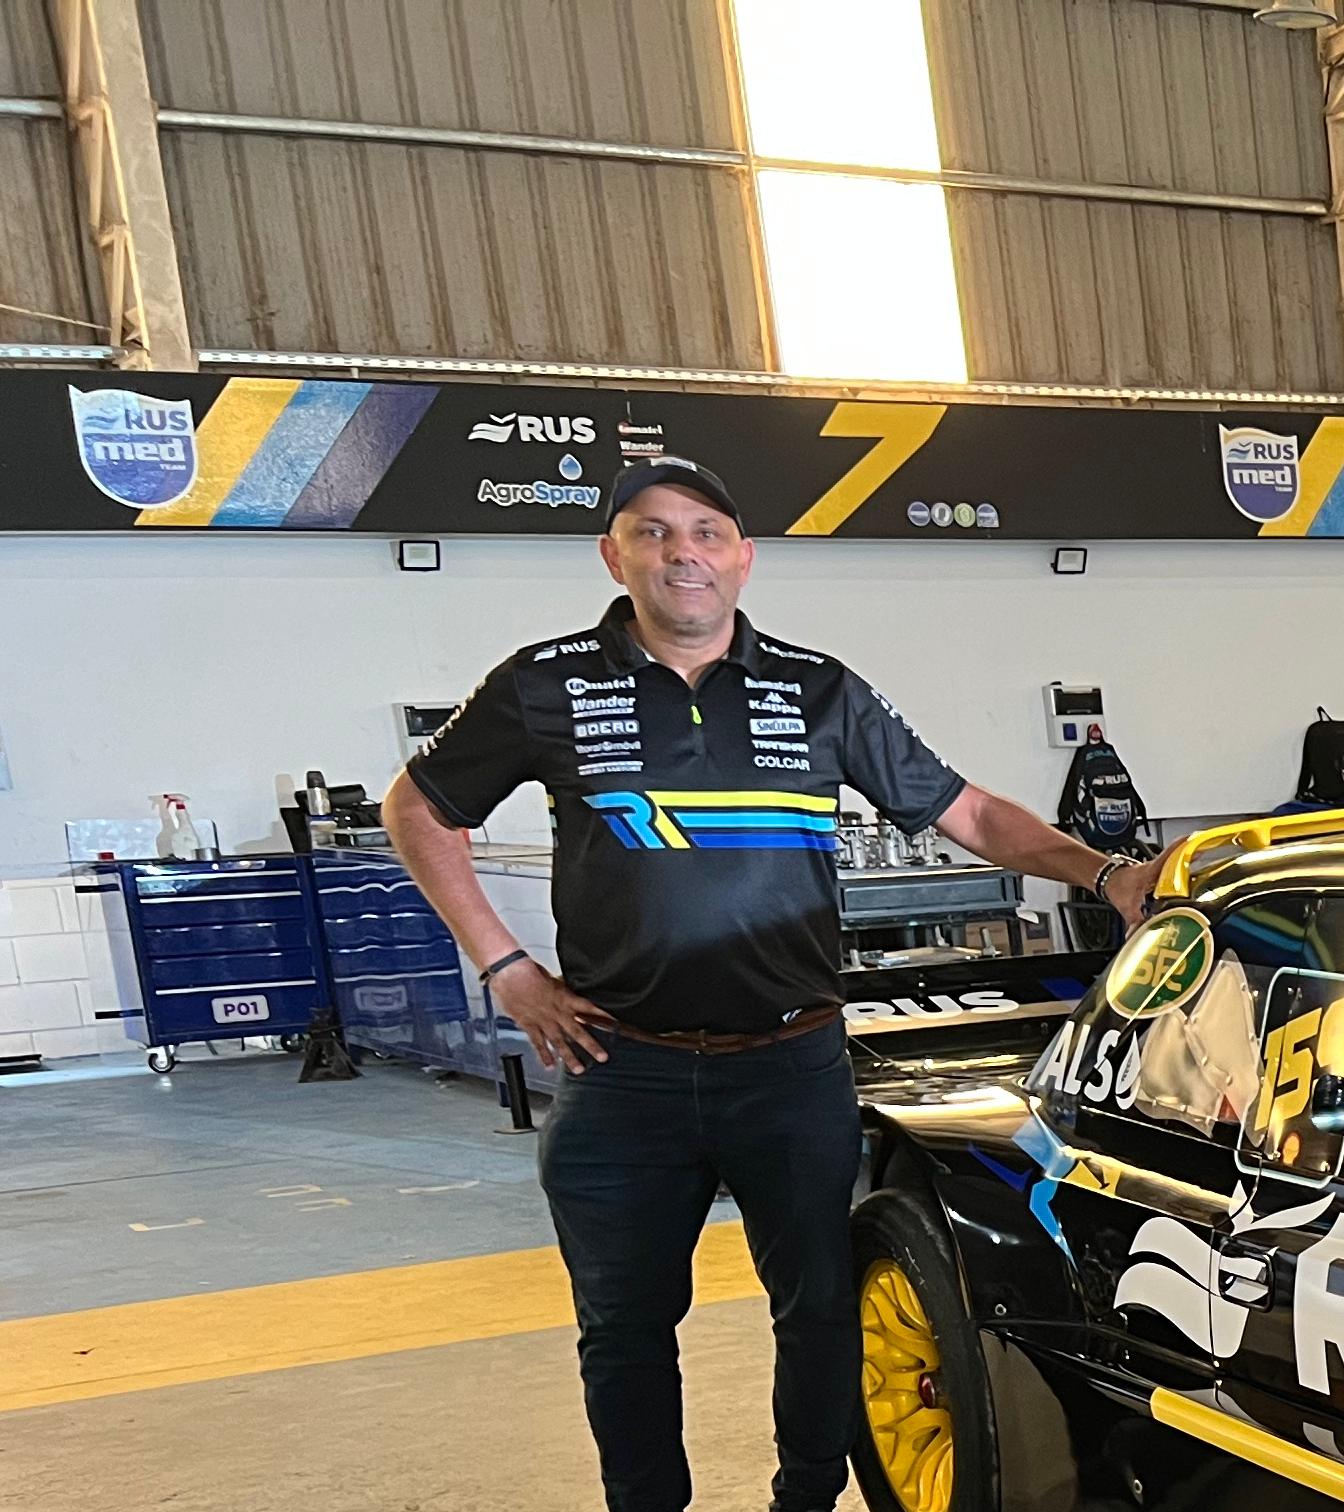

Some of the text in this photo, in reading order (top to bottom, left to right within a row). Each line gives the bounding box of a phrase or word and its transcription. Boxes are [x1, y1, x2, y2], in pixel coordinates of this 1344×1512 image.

[124, 408, 189, 431] RUS
[517, 414, 597, 444] RUS
[92, 438, 187, 463] med
[1253, 442, 1295, 461] RUS
[784, 402, 948, 536] 7
[1232, 465, 1293, 488] med
[478, 479, 600, 508] AgroSpray
[559, 639, 601, 654] RUS
[571, 695, 637, 712] Wander
[748, 699, 802, 715] Kappa
[575, 720, 640, 739] BOERO
[753, 754, 811, 772] COLCAR
[841, 991, 1020, 1026] RUS
[1253, 1007, 1324, 1134] 15
